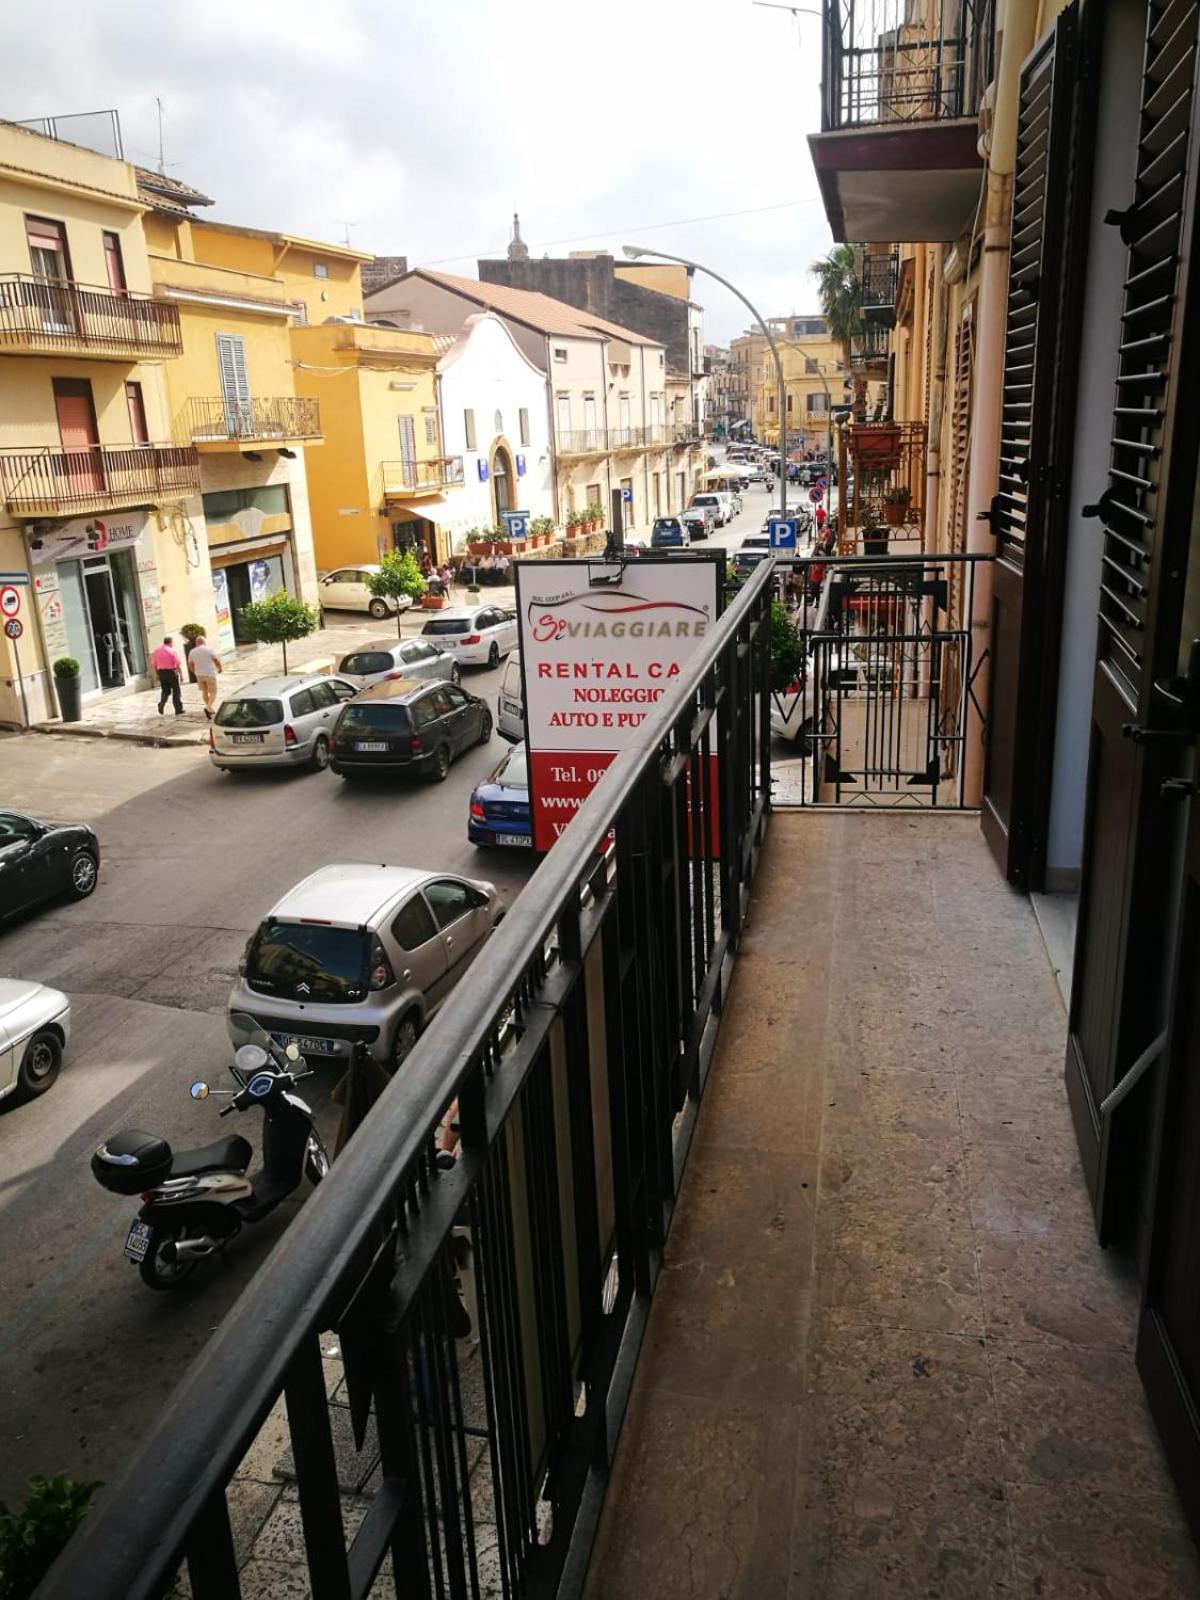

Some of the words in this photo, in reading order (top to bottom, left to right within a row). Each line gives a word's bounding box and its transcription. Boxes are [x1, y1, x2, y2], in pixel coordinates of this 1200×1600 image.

[511, 519, 522, 536] P
[775, 523, 792, 546] P
[538, 663, 639, 678] RENTAL
[648, 663, 681, 678] CA
[549, 712, 597, 727] AUTO
[603, 713, 613, 727] E
[551, 767, 581, 782] Tel.
